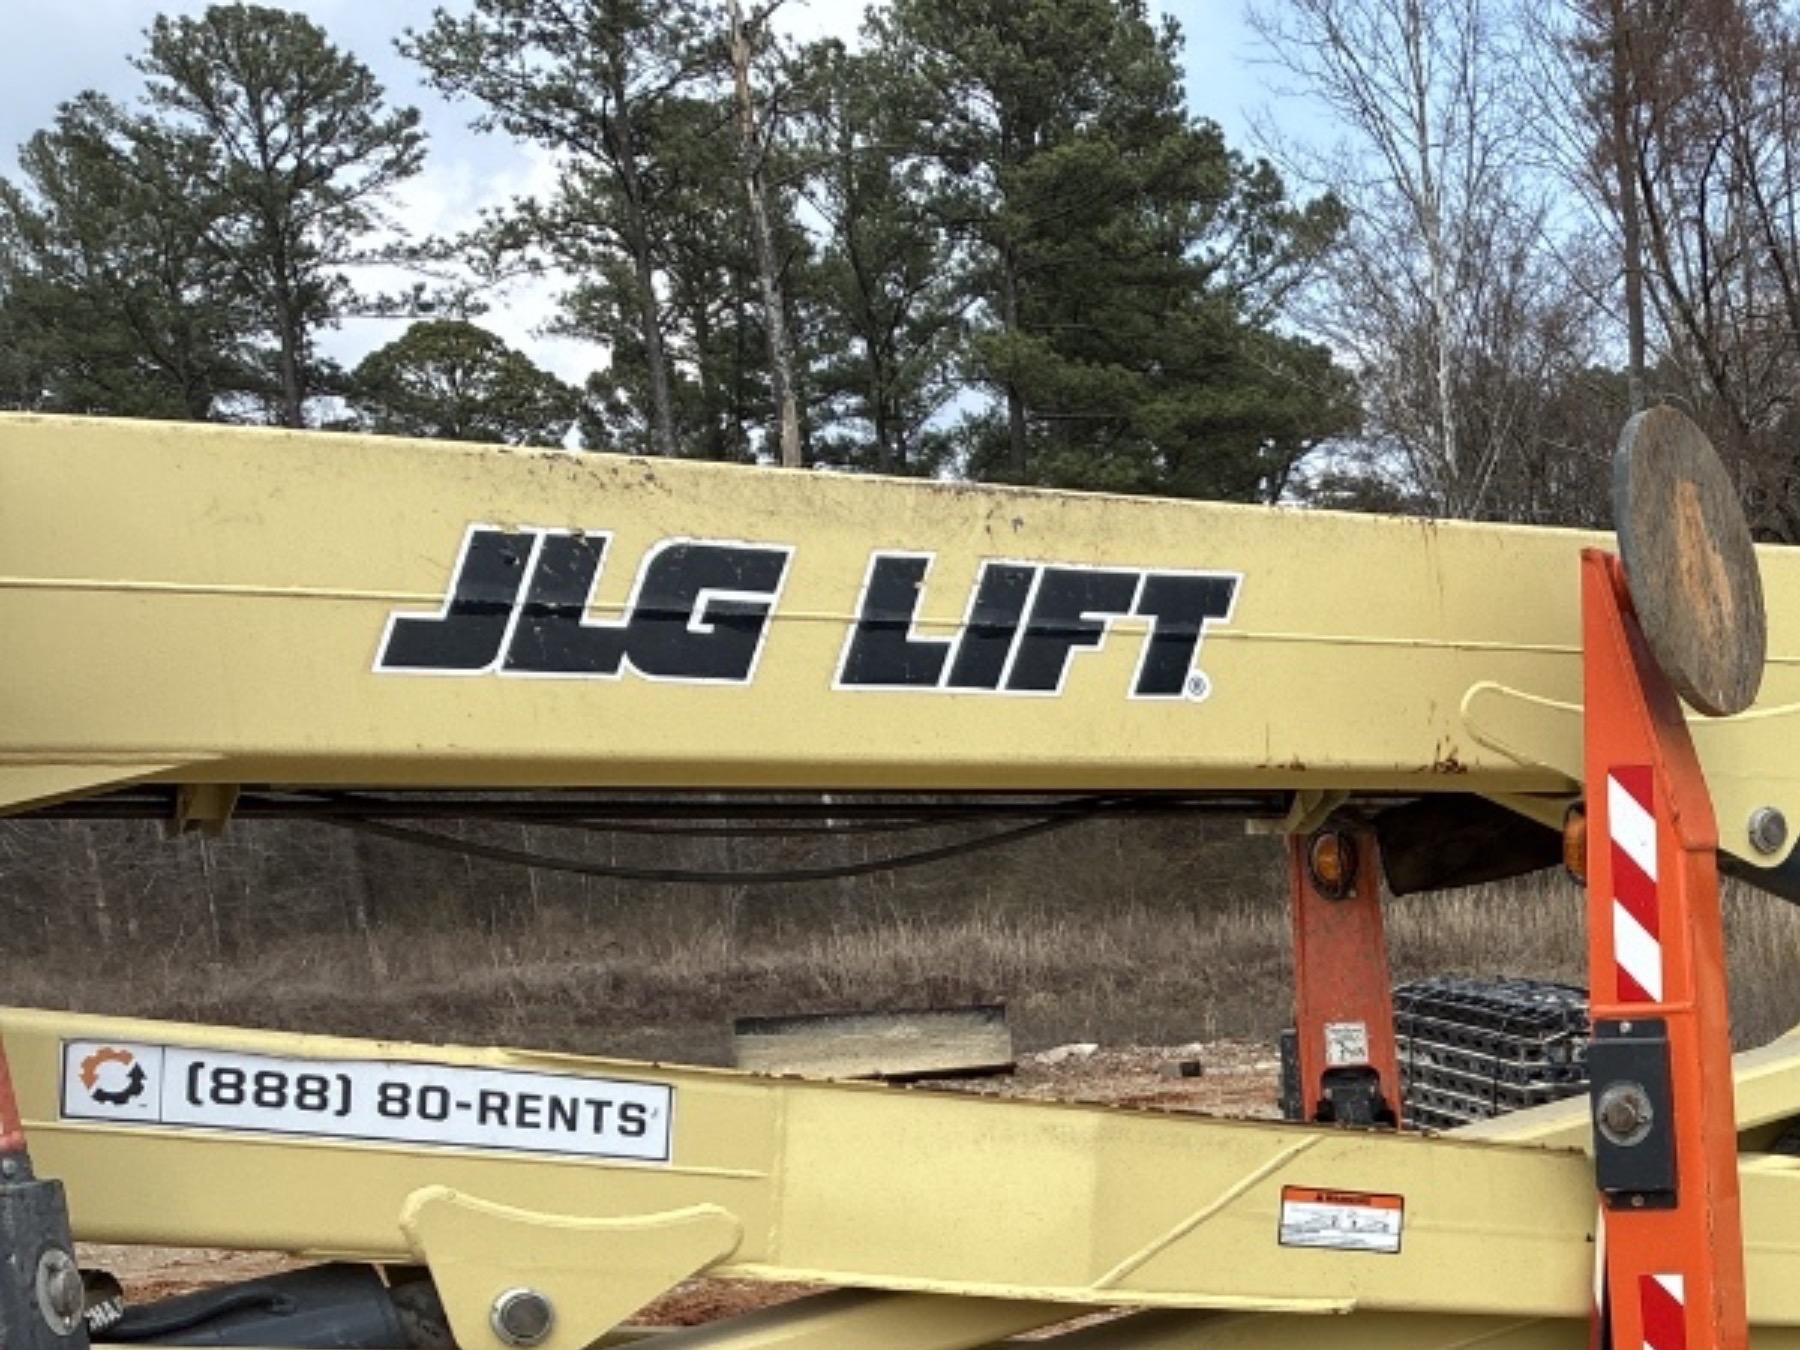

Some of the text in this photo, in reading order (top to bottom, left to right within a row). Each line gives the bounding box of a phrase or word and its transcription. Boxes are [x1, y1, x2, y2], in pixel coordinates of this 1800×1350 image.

[371, 523, 796, 684] JLG
[186, 1061, 648, 1138] (888) 80-RENTS
